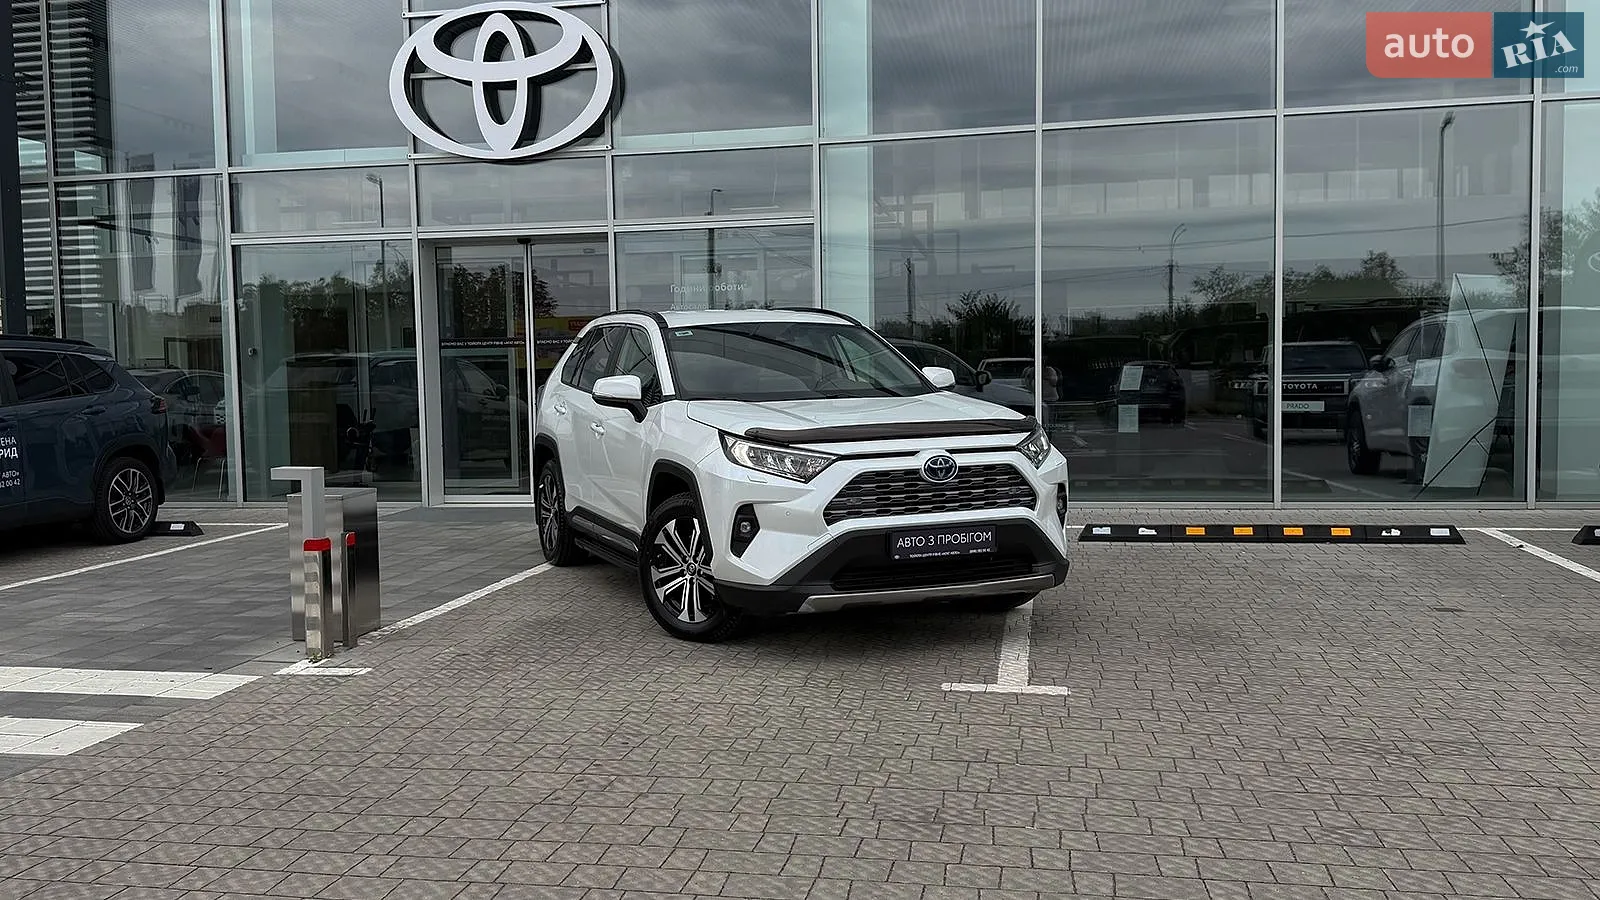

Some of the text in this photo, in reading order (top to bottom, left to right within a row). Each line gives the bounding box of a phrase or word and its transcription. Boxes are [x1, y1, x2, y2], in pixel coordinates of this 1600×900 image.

[710, 282, 744, 293] оботи
[1286, 402, 1310, 410] PRADO
[896, 536, 926, 548] АВТО
[937, 531, 992, 545] ПРОБІГОМ
